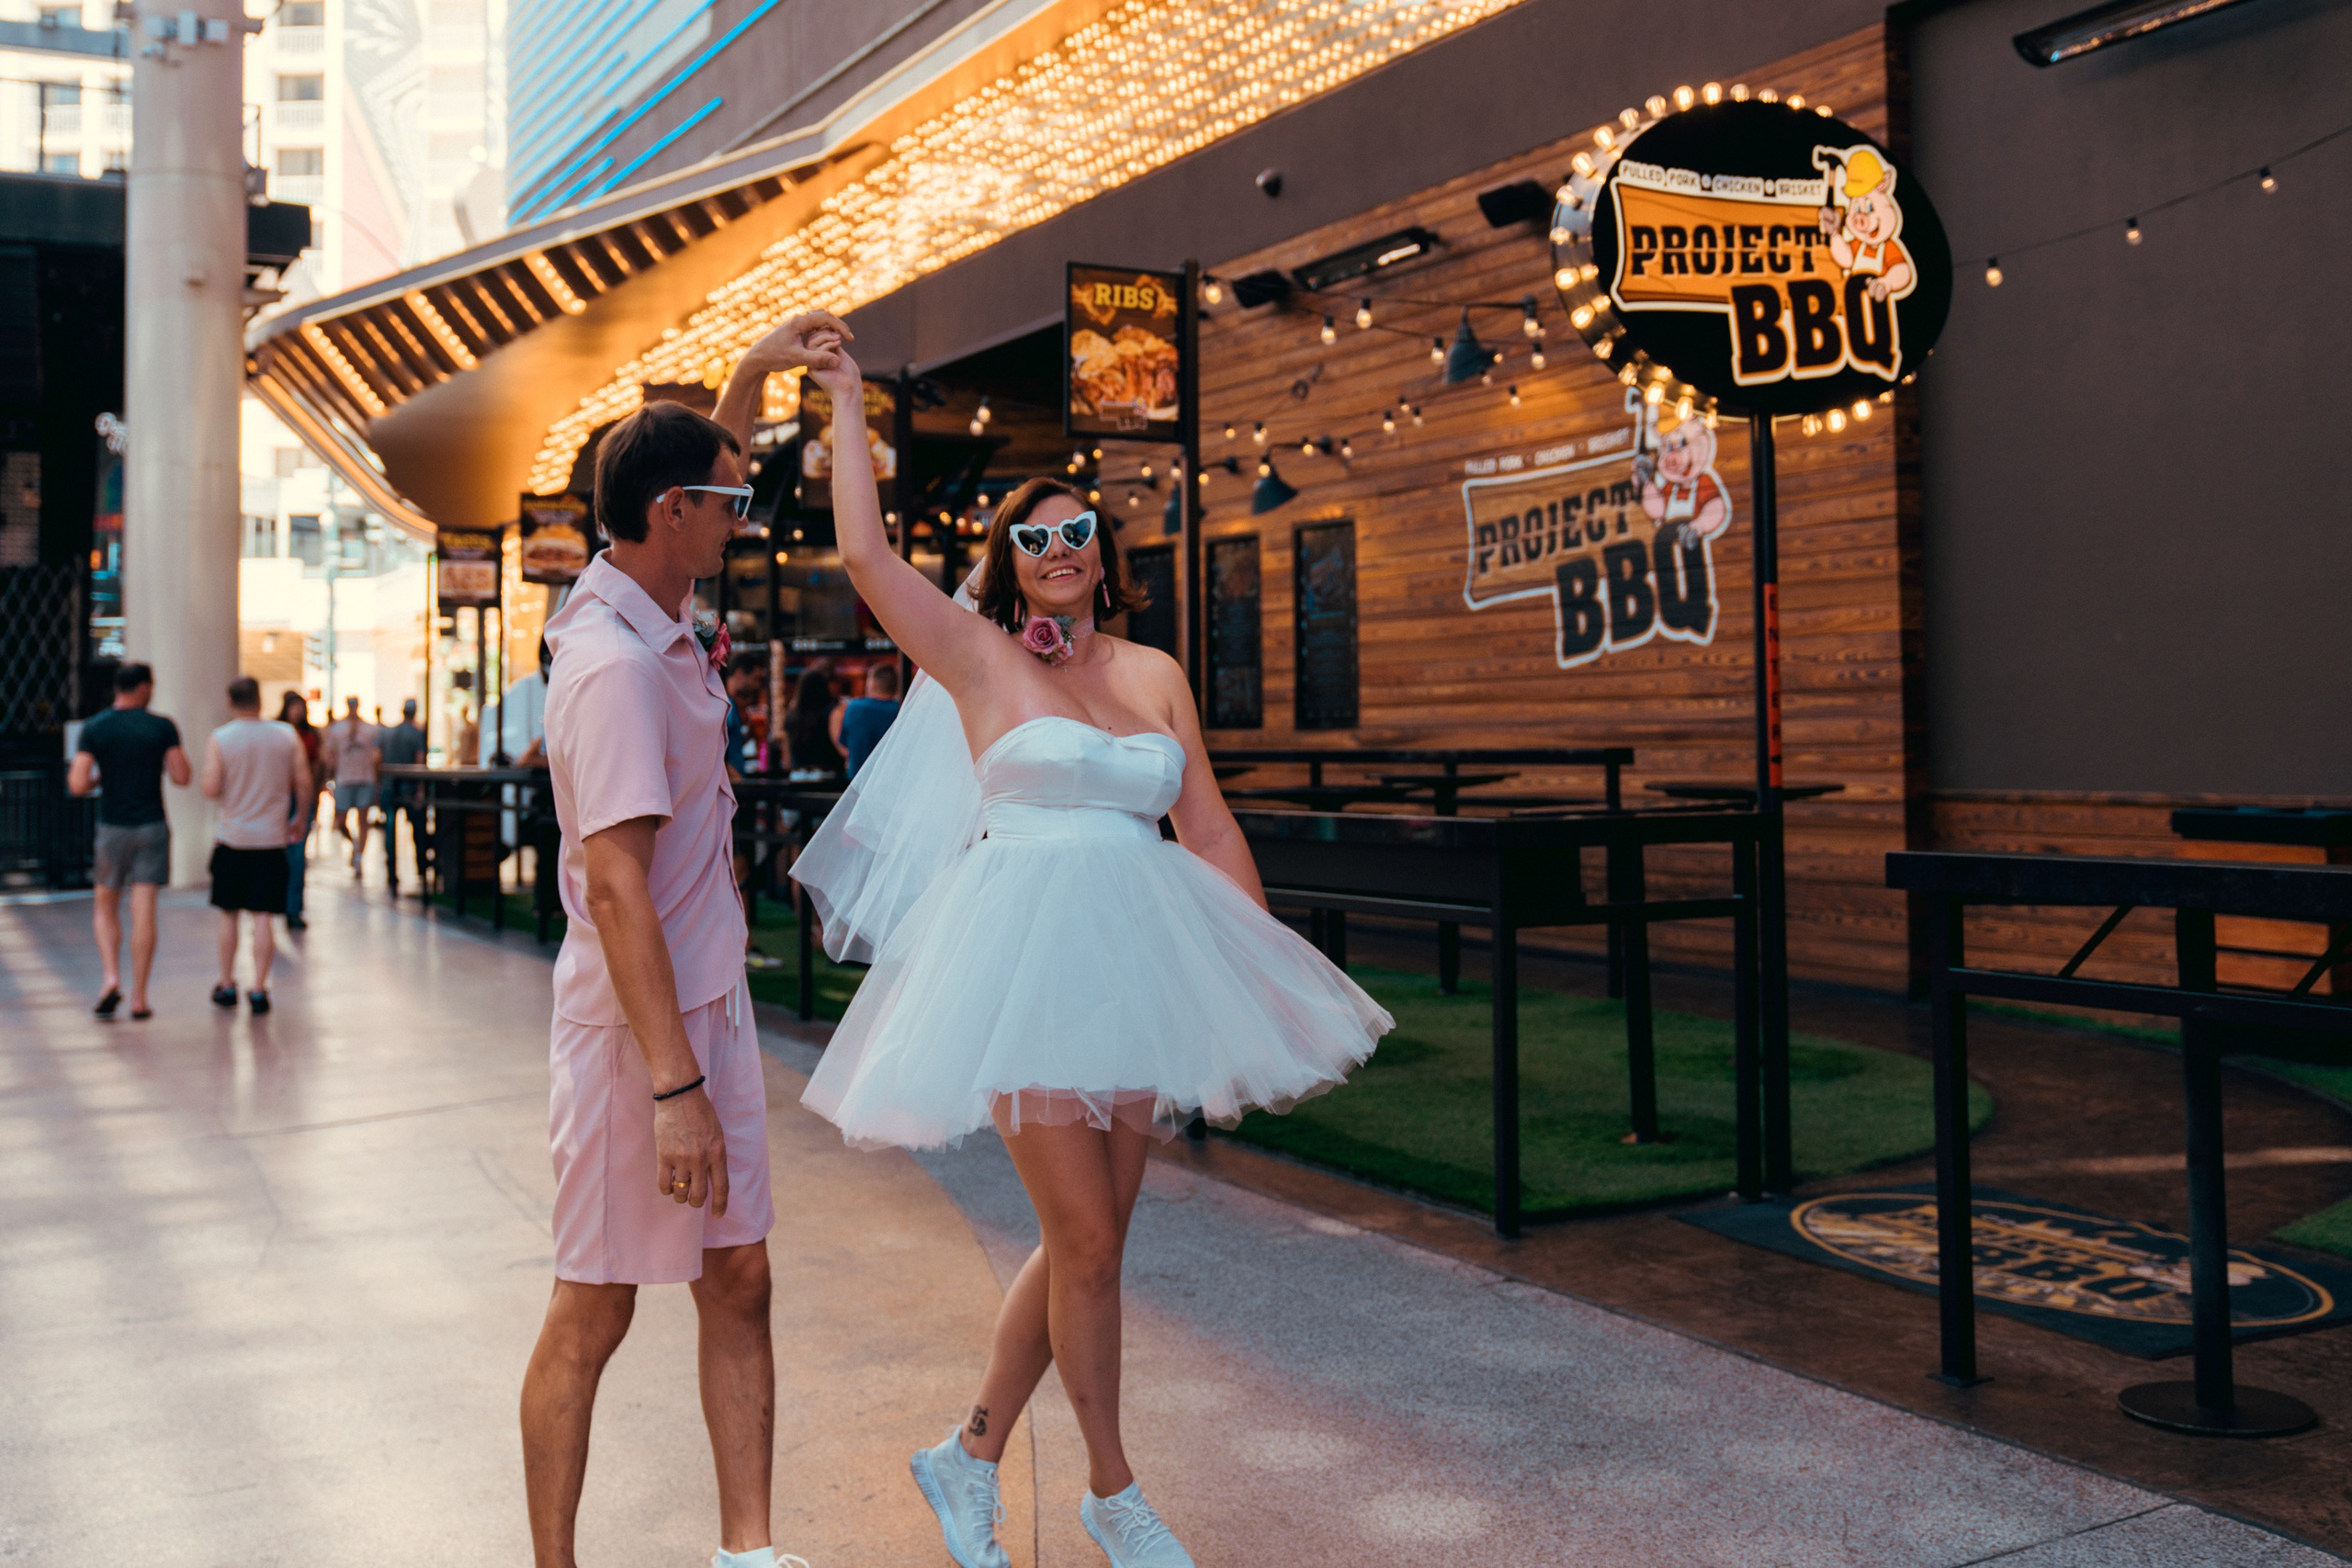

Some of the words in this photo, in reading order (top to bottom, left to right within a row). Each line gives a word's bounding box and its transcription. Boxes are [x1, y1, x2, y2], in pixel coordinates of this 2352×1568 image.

[1623, 164, 1663, 183] PULLED
[1668, 174, 1698, 187] PORK
[1714, 179, 1761, 194] CHICKEN
[1778, 182, 1822, 197] BRISKET
[1093, 282, 1156, 310] RIBS
[1631, 225, 1828, 275] PROJECT
[1732, 274, 1895, 374] BBQ
[1476, 479, 1644, 575] PROJECT
[1555, 517, 1714, 658] BBQ
[1768, 593, 1781, 739] ENTER
